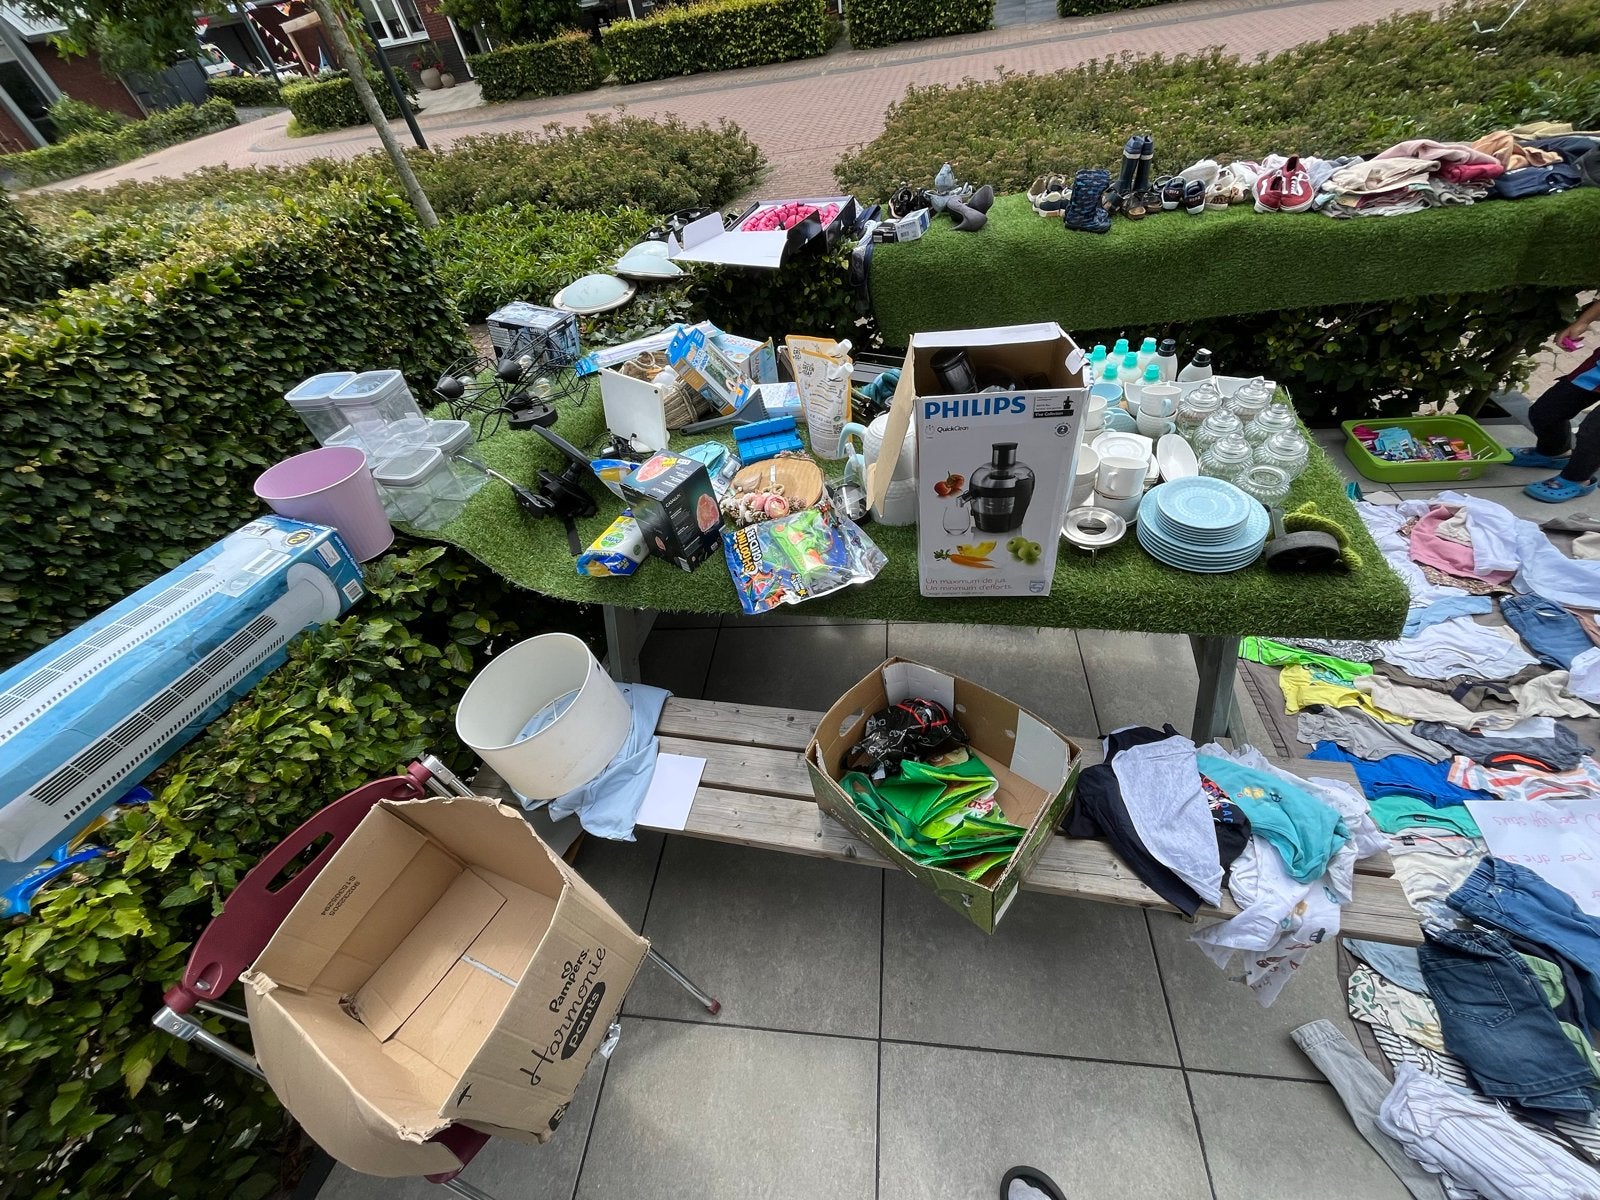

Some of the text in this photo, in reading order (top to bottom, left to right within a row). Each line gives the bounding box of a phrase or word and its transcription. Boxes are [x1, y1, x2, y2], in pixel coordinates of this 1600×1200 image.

[924, 396, 1026, 419] PHILIPS
[936, 424, 969, 433] QuickClean
[1523, 854, 1551, 865] drie
[1560, 848, 1593, 863] per
[548, 949, 590, 1013] Pampers
[519, 948, 606, 1086] Harmonie
[568, 991, 600, 1049] pants
